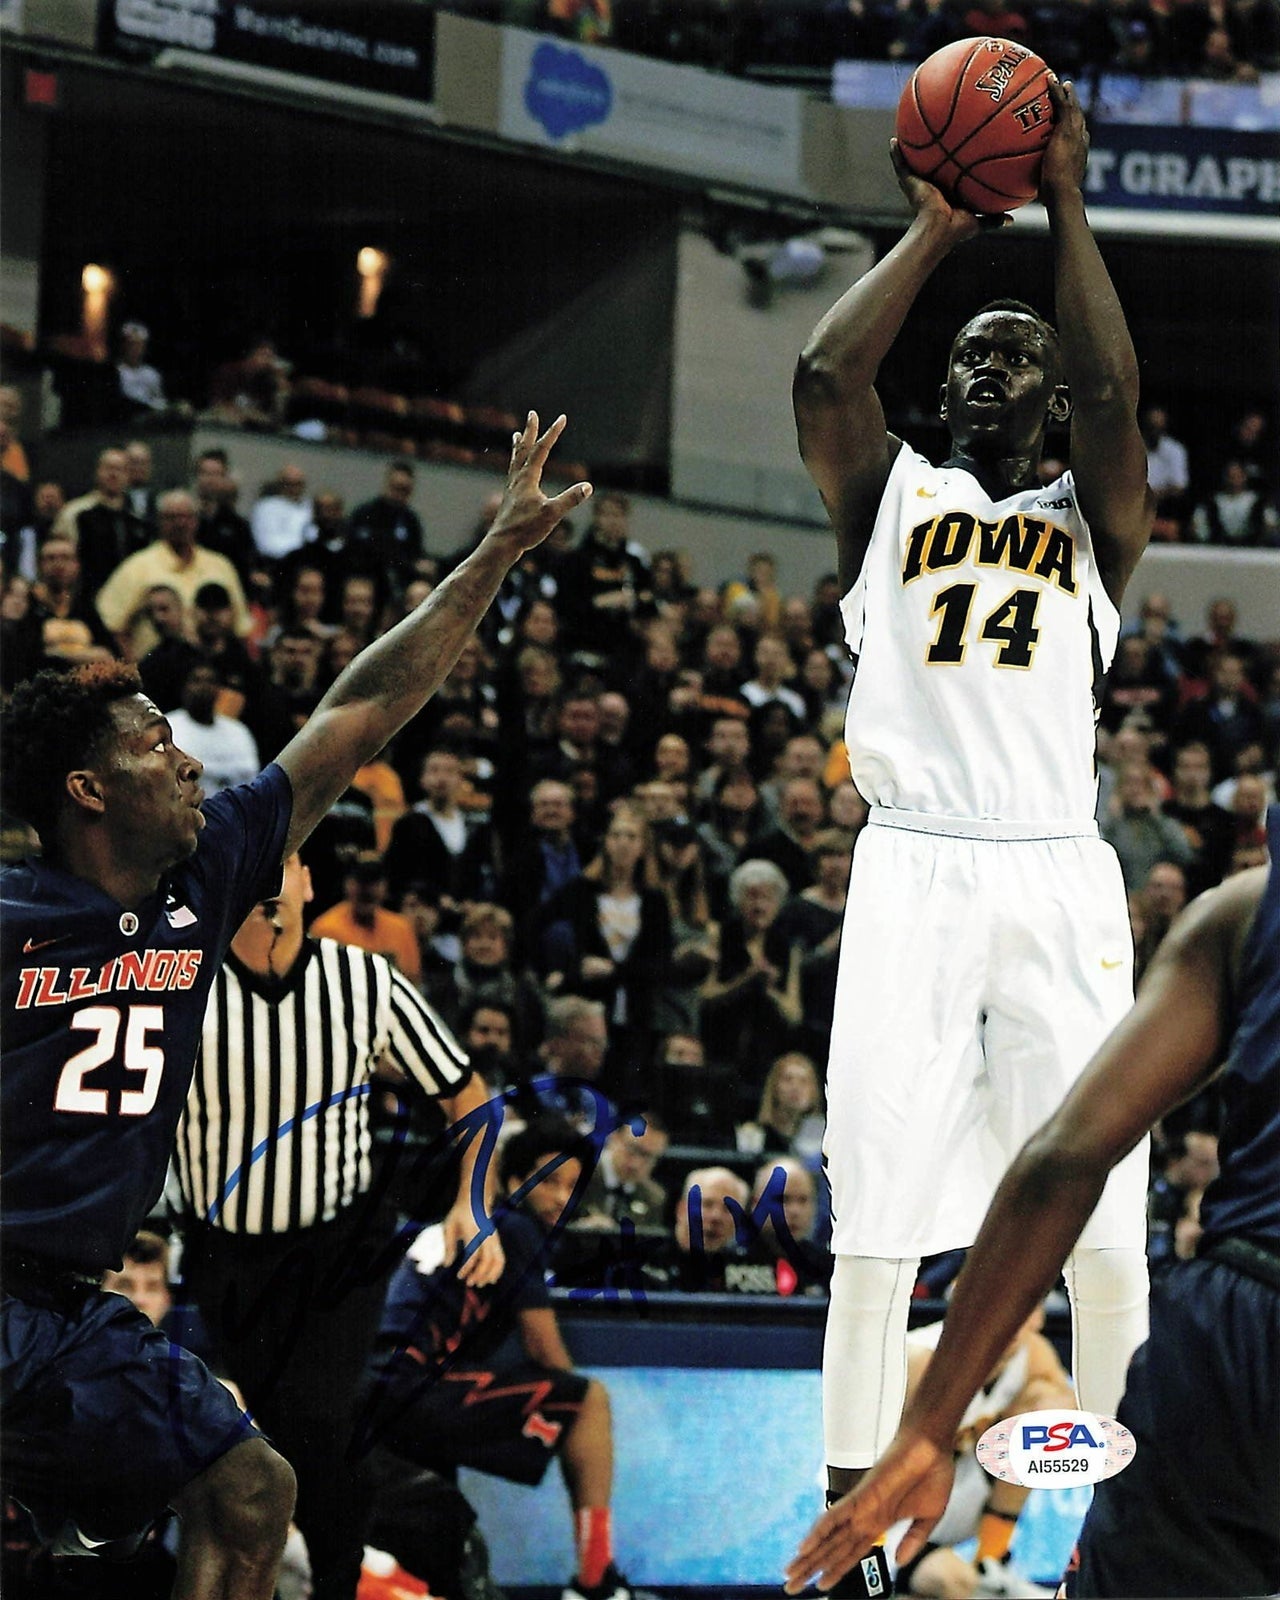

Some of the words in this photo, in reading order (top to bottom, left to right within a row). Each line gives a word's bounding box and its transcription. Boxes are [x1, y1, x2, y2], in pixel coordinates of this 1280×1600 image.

[902, 510, 1080, 599] IOWA
[925, 579, 1043, 671] 14
[15, 948, 203, 1010] ILLINOIS
[53, 1003, 166, 1117] 25
